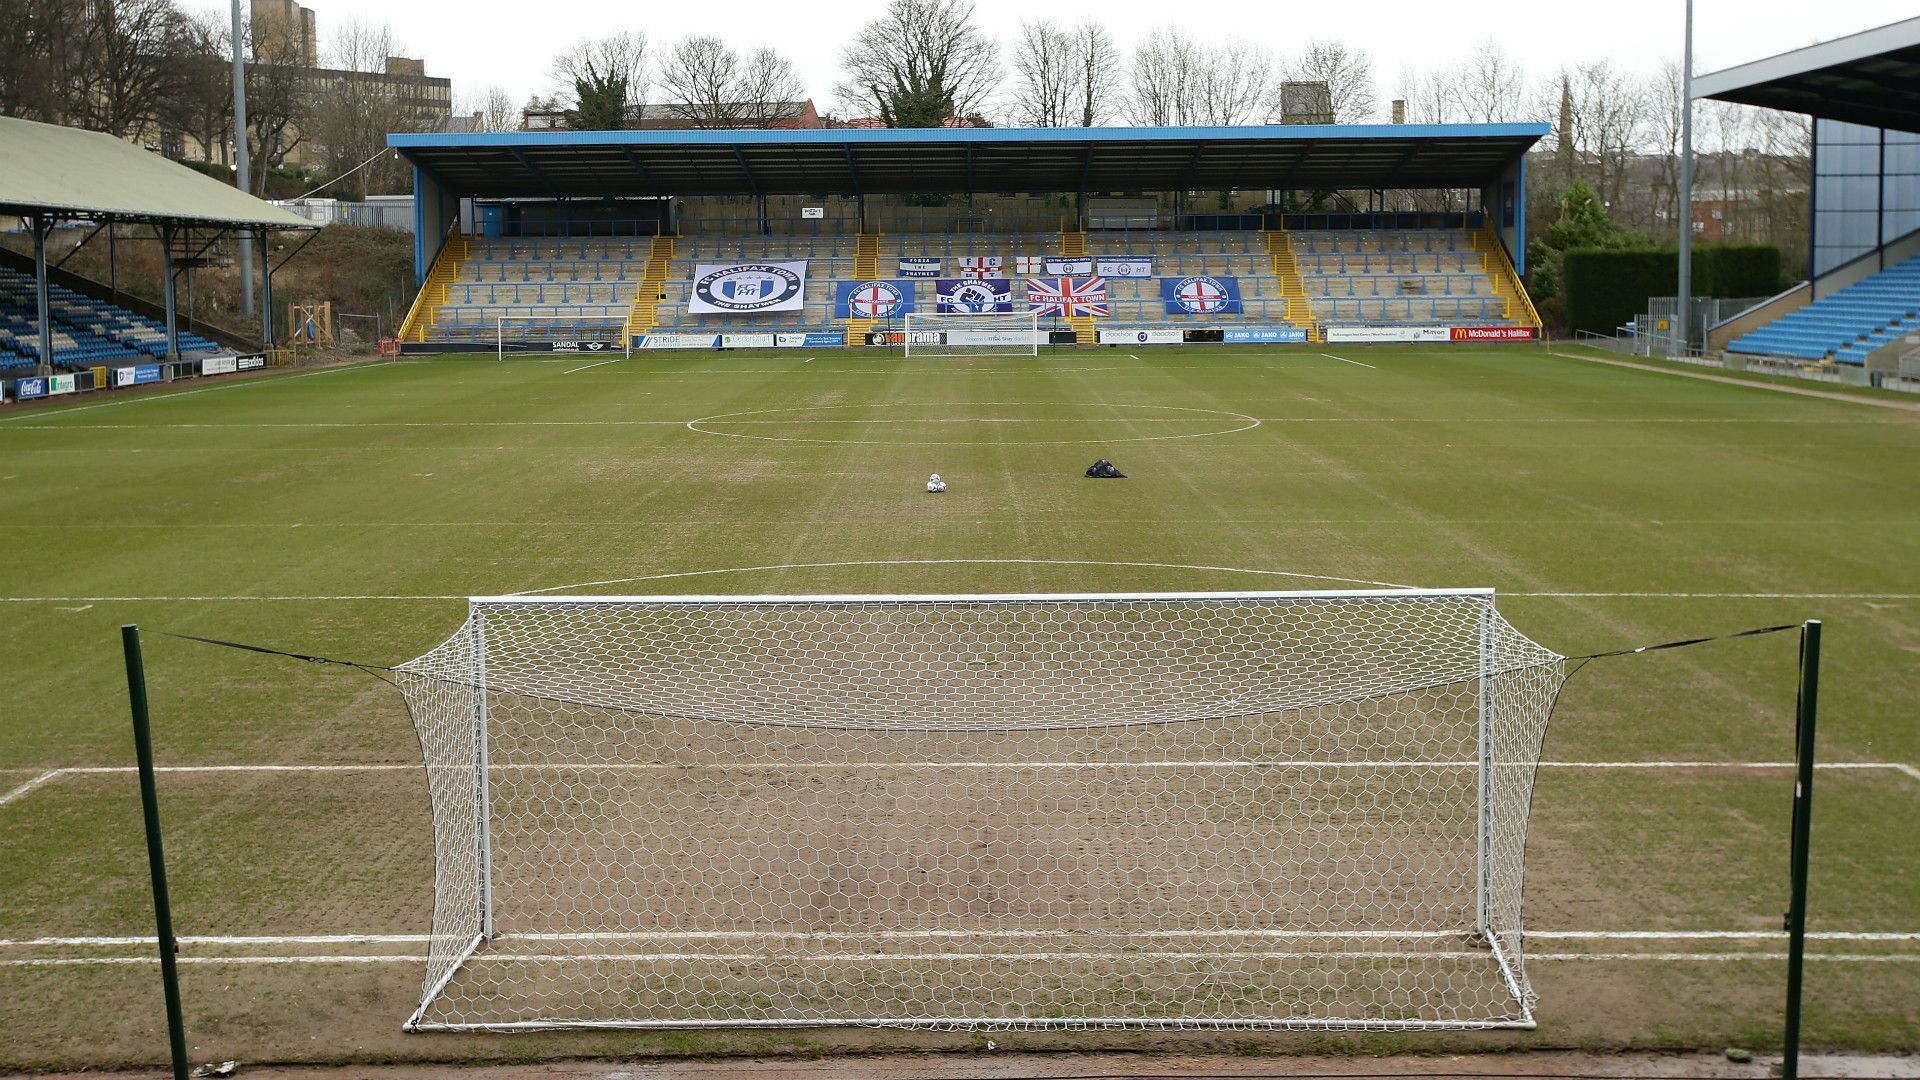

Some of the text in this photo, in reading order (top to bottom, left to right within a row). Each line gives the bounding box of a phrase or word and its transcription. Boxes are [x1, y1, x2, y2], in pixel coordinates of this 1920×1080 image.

[966, 258, 996, 266] F C
[699, 265, 798, 285] FC HALIFAX TOWN
[861, 282, 884, 290] HALIFAX
[886, 285, 899, 296] TOWN
[950, 280, 996, 293] THE SHAYMEN
[1184, 277, 1207, 286] HALIFAX
[1209, 280, 1223, 292] TOWN
[714, 298, 782, 309] THE SHAYMEN
[1080, 294, 1105, 302] TOWN
[653, 335, 680, 343] STRIDE
[1469, 329, 1530, 338] McDonald's Halifax
[248, 355, 264, 368] adidas
